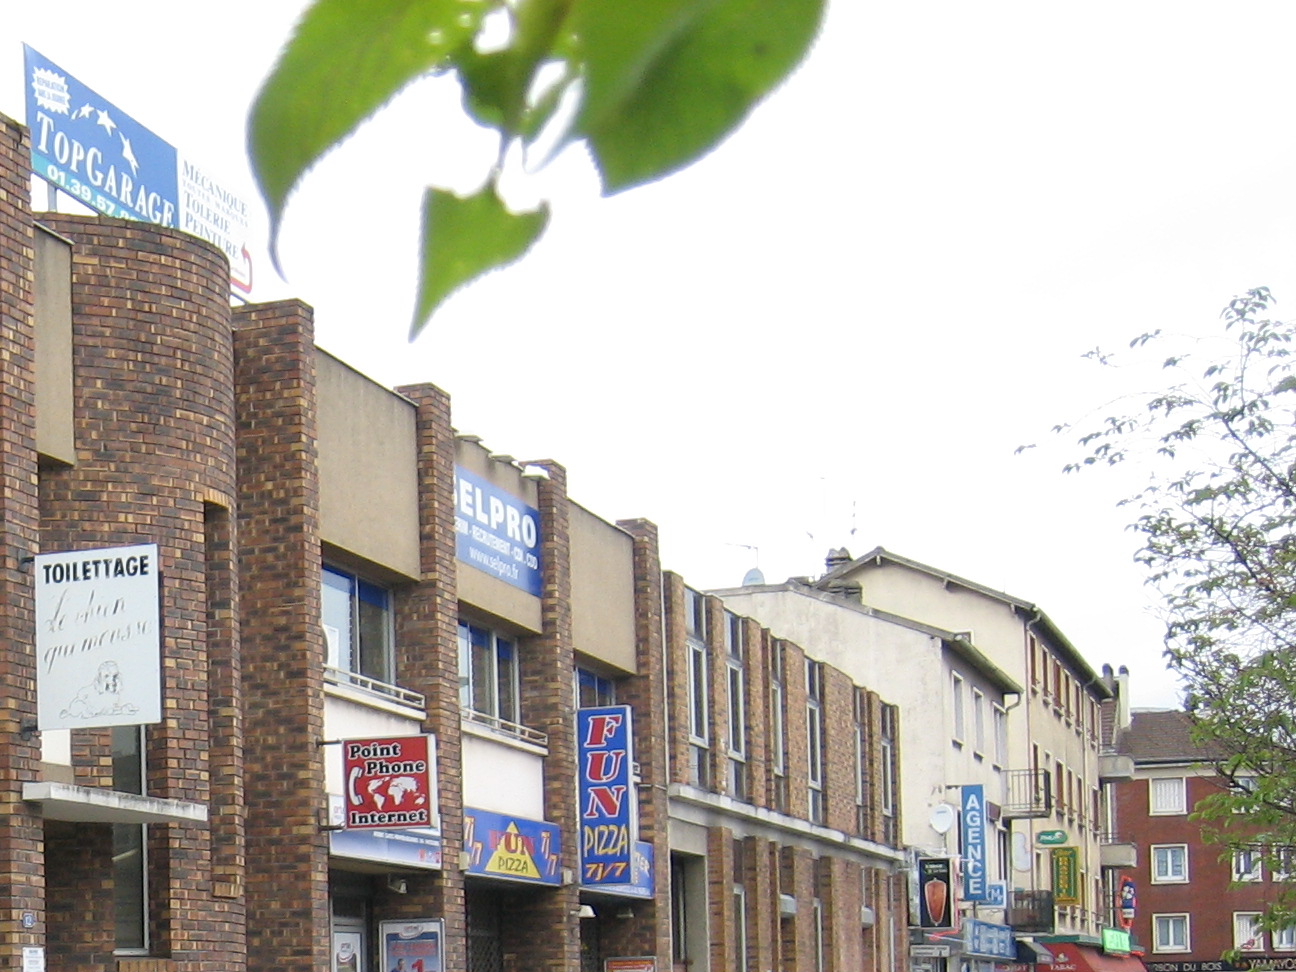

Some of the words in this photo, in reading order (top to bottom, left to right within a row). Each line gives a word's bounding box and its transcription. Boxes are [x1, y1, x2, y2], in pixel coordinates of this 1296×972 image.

[36, 111, 175, 229] TOPGARAGE
[454, 476, 537, 549] ELPRO
[43, 555, 149, 584] TOILETTAGE
[349, 742, 401, 760] Point
[583, 714, 627, 819] FUN
[366, 759, 426, 776] Phone
[350, 809, 428, 826] Internet
[584, 824, 628, 858] PIZZA
[966, 793, 983, 895] AGENCE
[497, 855, 529, 874] PIZZA
